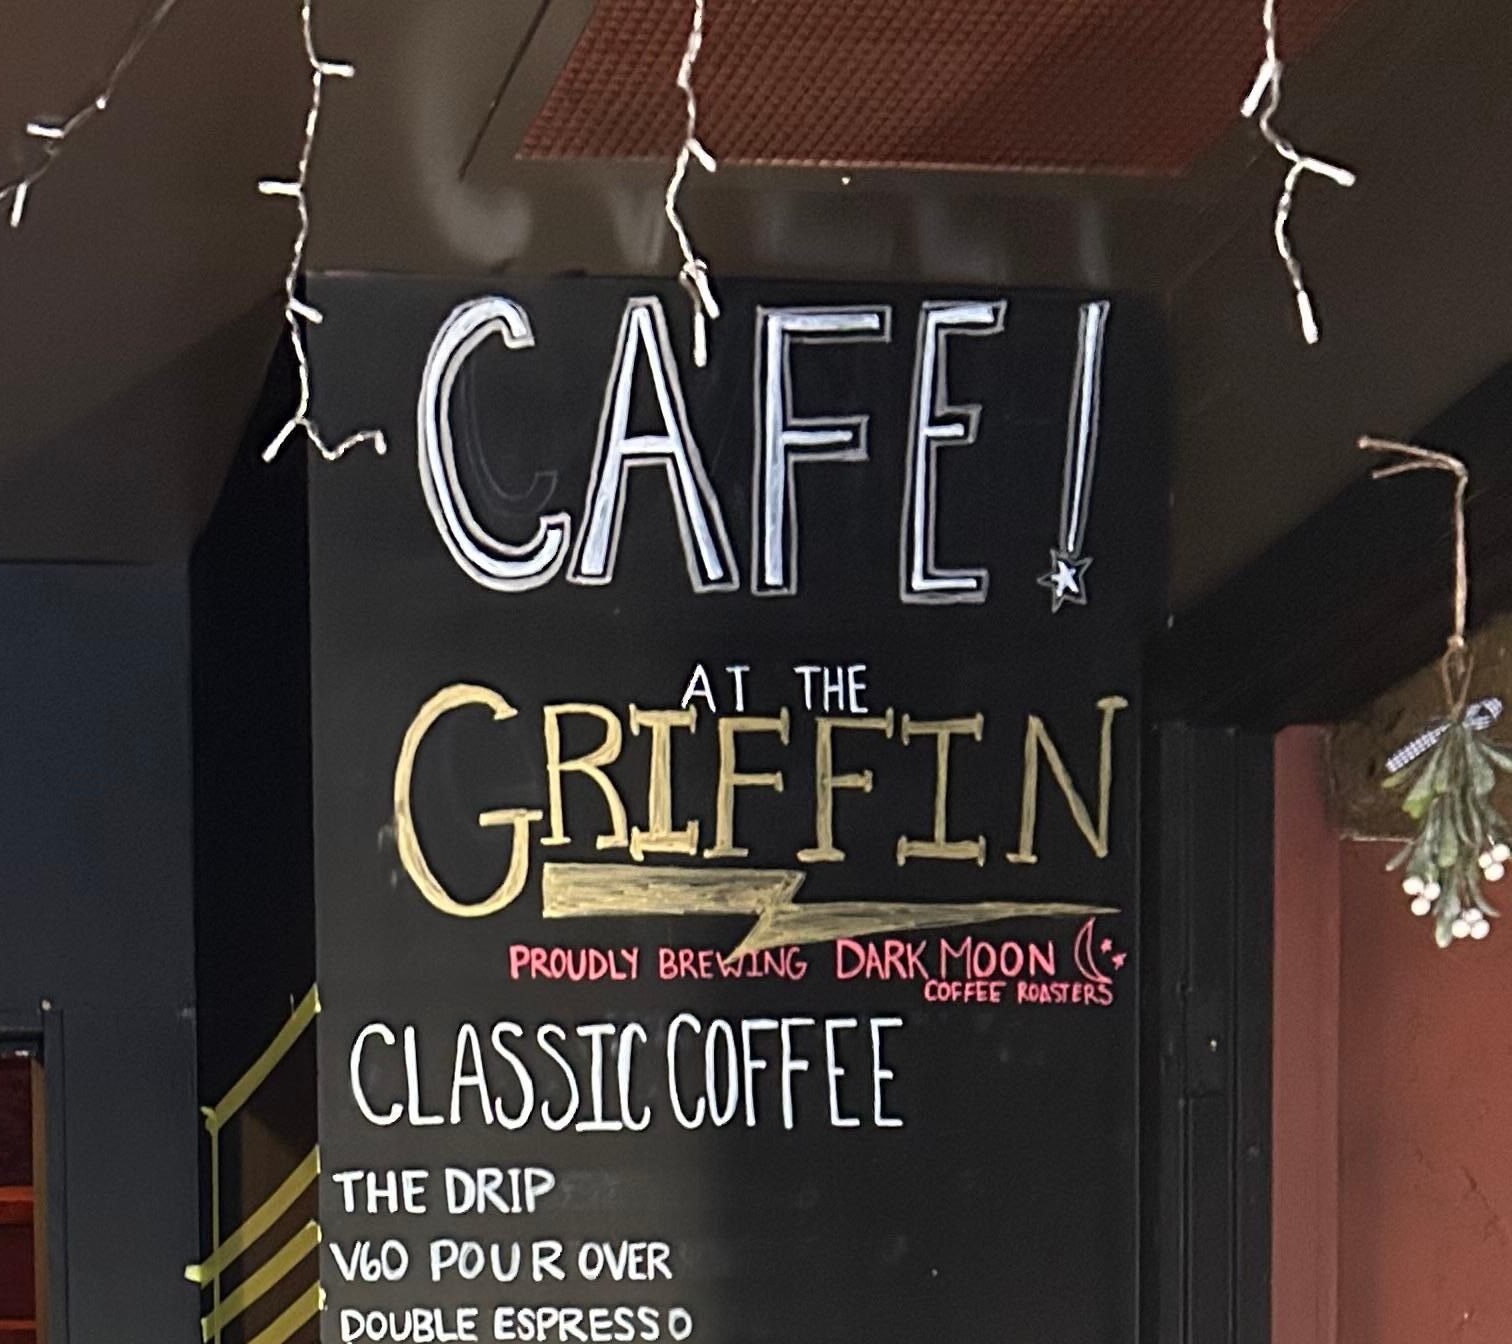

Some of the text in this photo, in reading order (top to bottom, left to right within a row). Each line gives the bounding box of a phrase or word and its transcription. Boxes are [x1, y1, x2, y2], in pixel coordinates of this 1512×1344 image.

[417, 295, 1109, 613] CAFE!
[682, 665, 869, 714] AT THE
[395, 683, 1129, 917] GRIFFIN
[510, 936, 1055, 980] PROUDLY BREWING DARK MOON
[924, 978, 1113, 1005] COFFEE ROASTERS
[350, 1012, 905, 1133] CLASSIC COFFEE
[332, 1166, 557, 1215] THE DRIP
[329, 1239, 674, 1282] V60 POUR OVER
[494, 1306, 693, 1344] ESPRESSO
